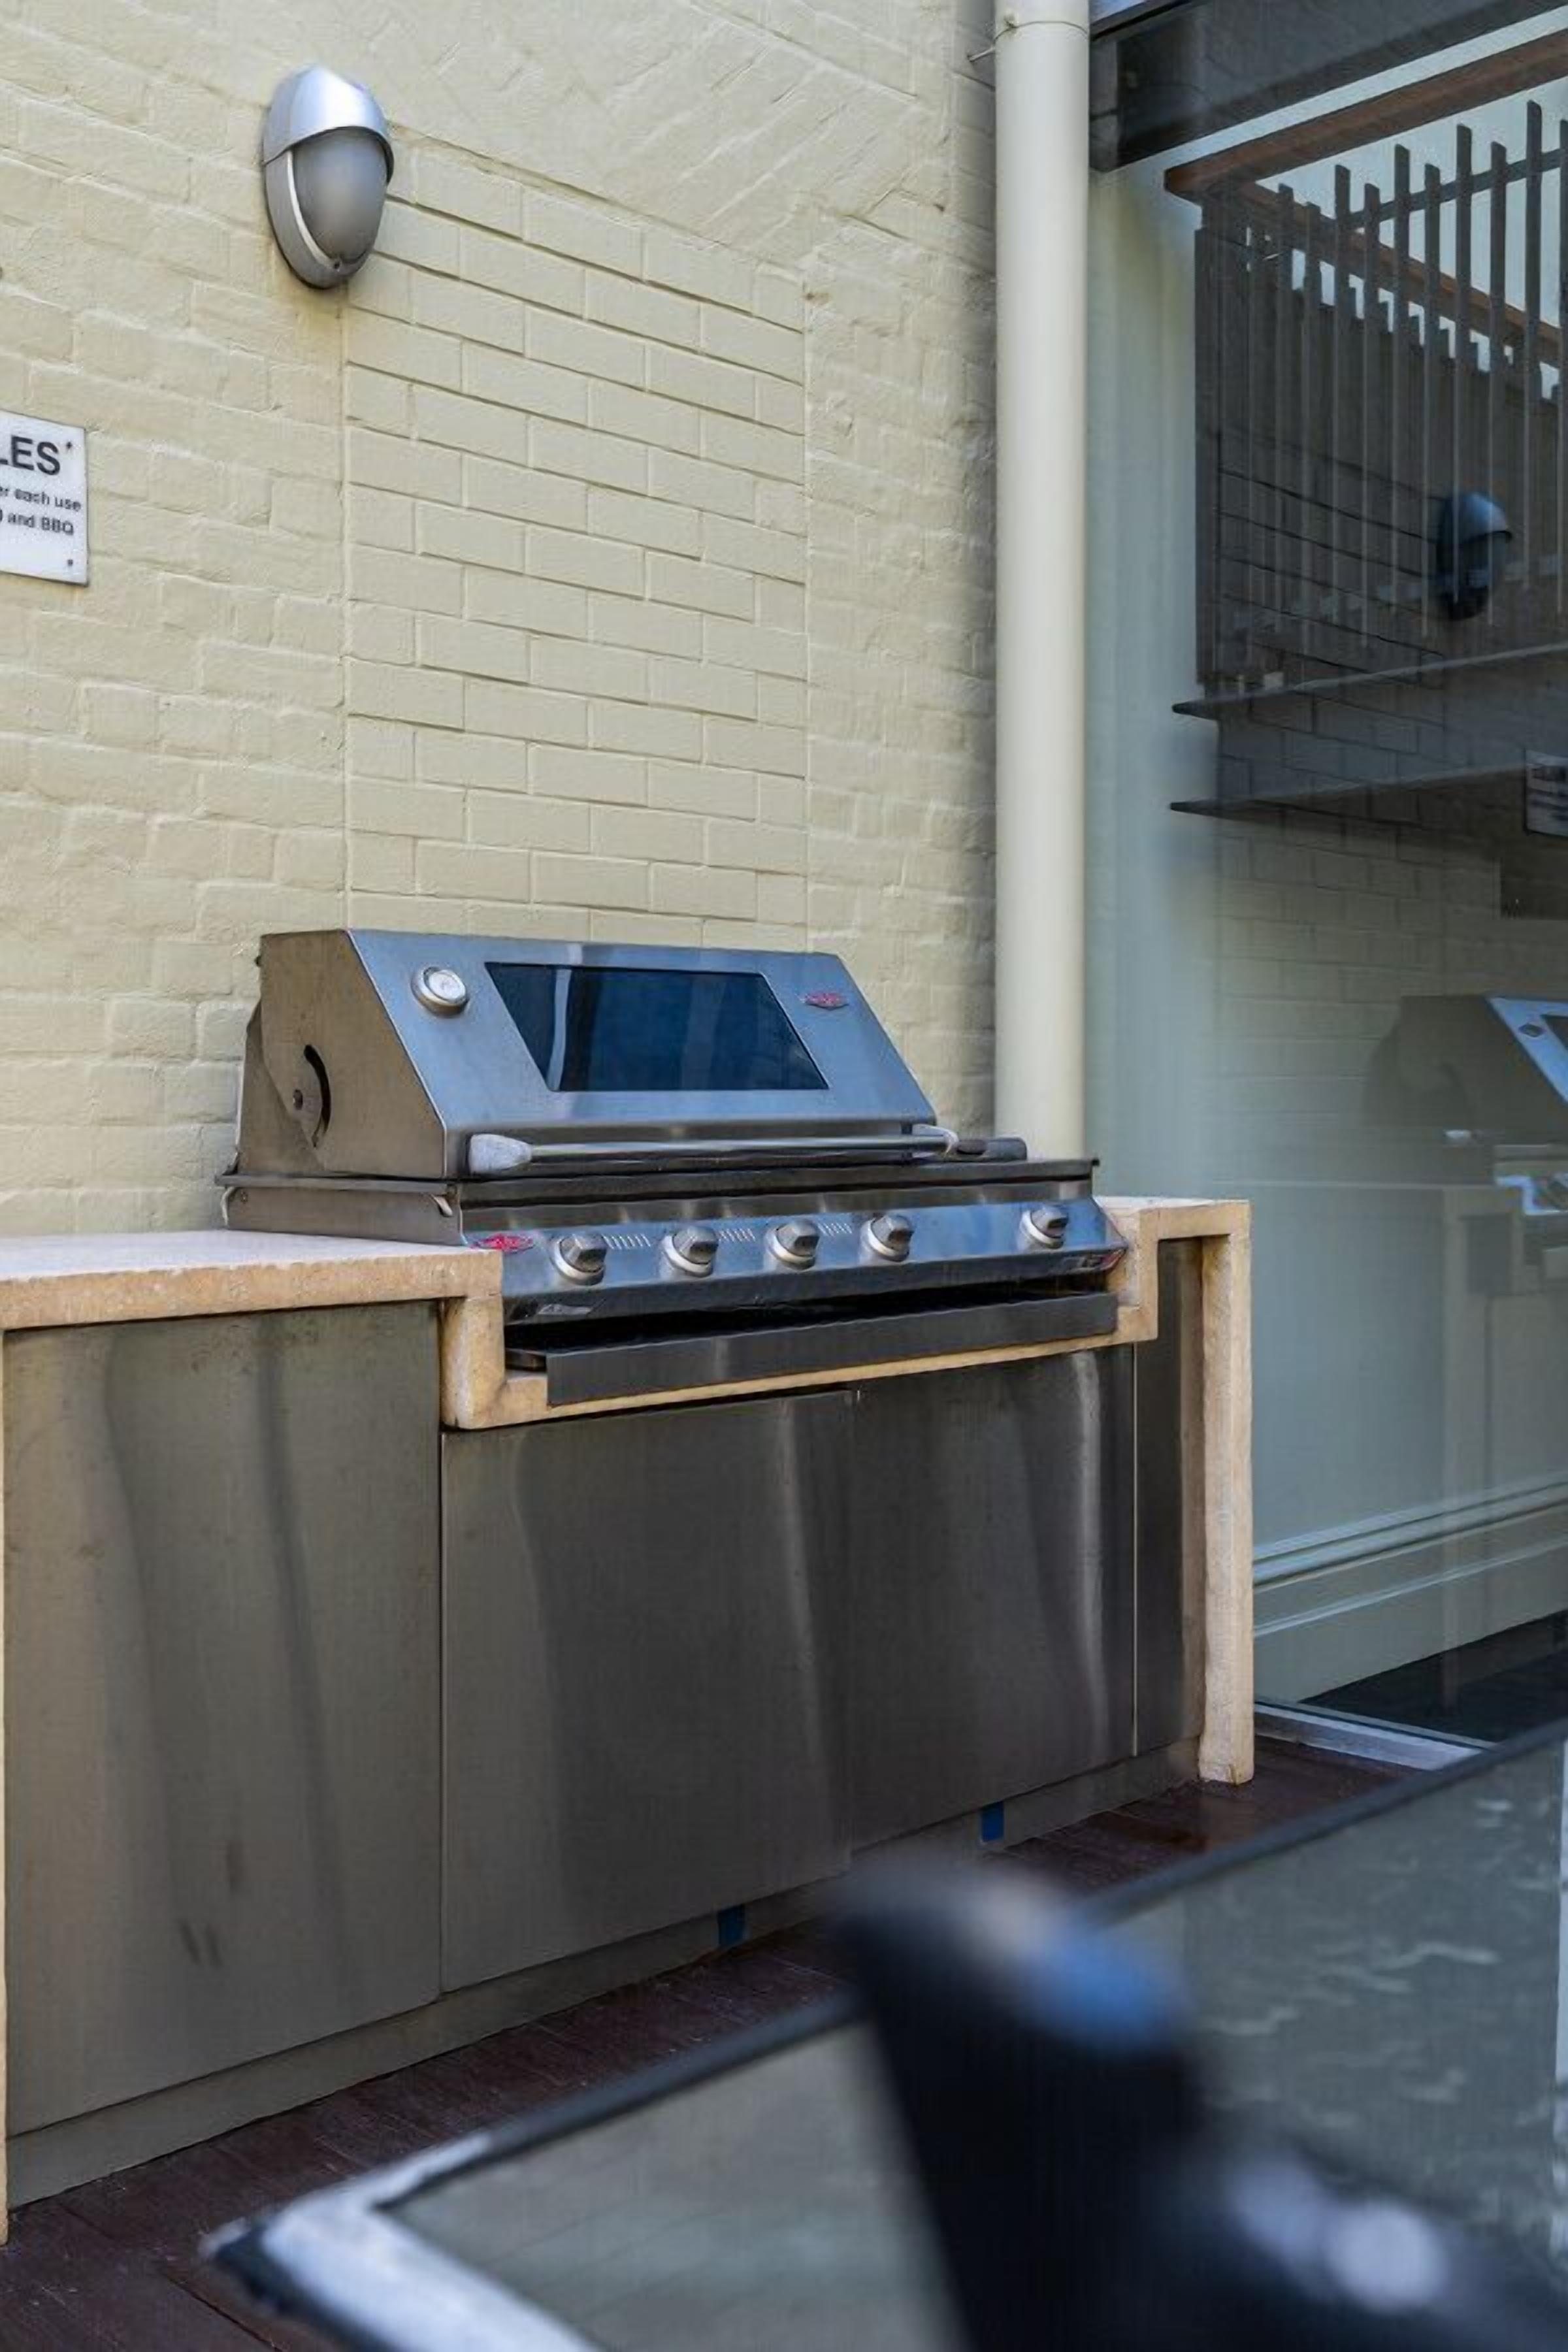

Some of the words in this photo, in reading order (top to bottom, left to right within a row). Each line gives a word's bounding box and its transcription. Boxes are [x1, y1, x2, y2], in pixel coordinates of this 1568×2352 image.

[14, 489, 50, 505] each
[55, 497, 81, 512] use
[8, 513, 35, 528] and
[41, 517, 74, 535] BBQ
